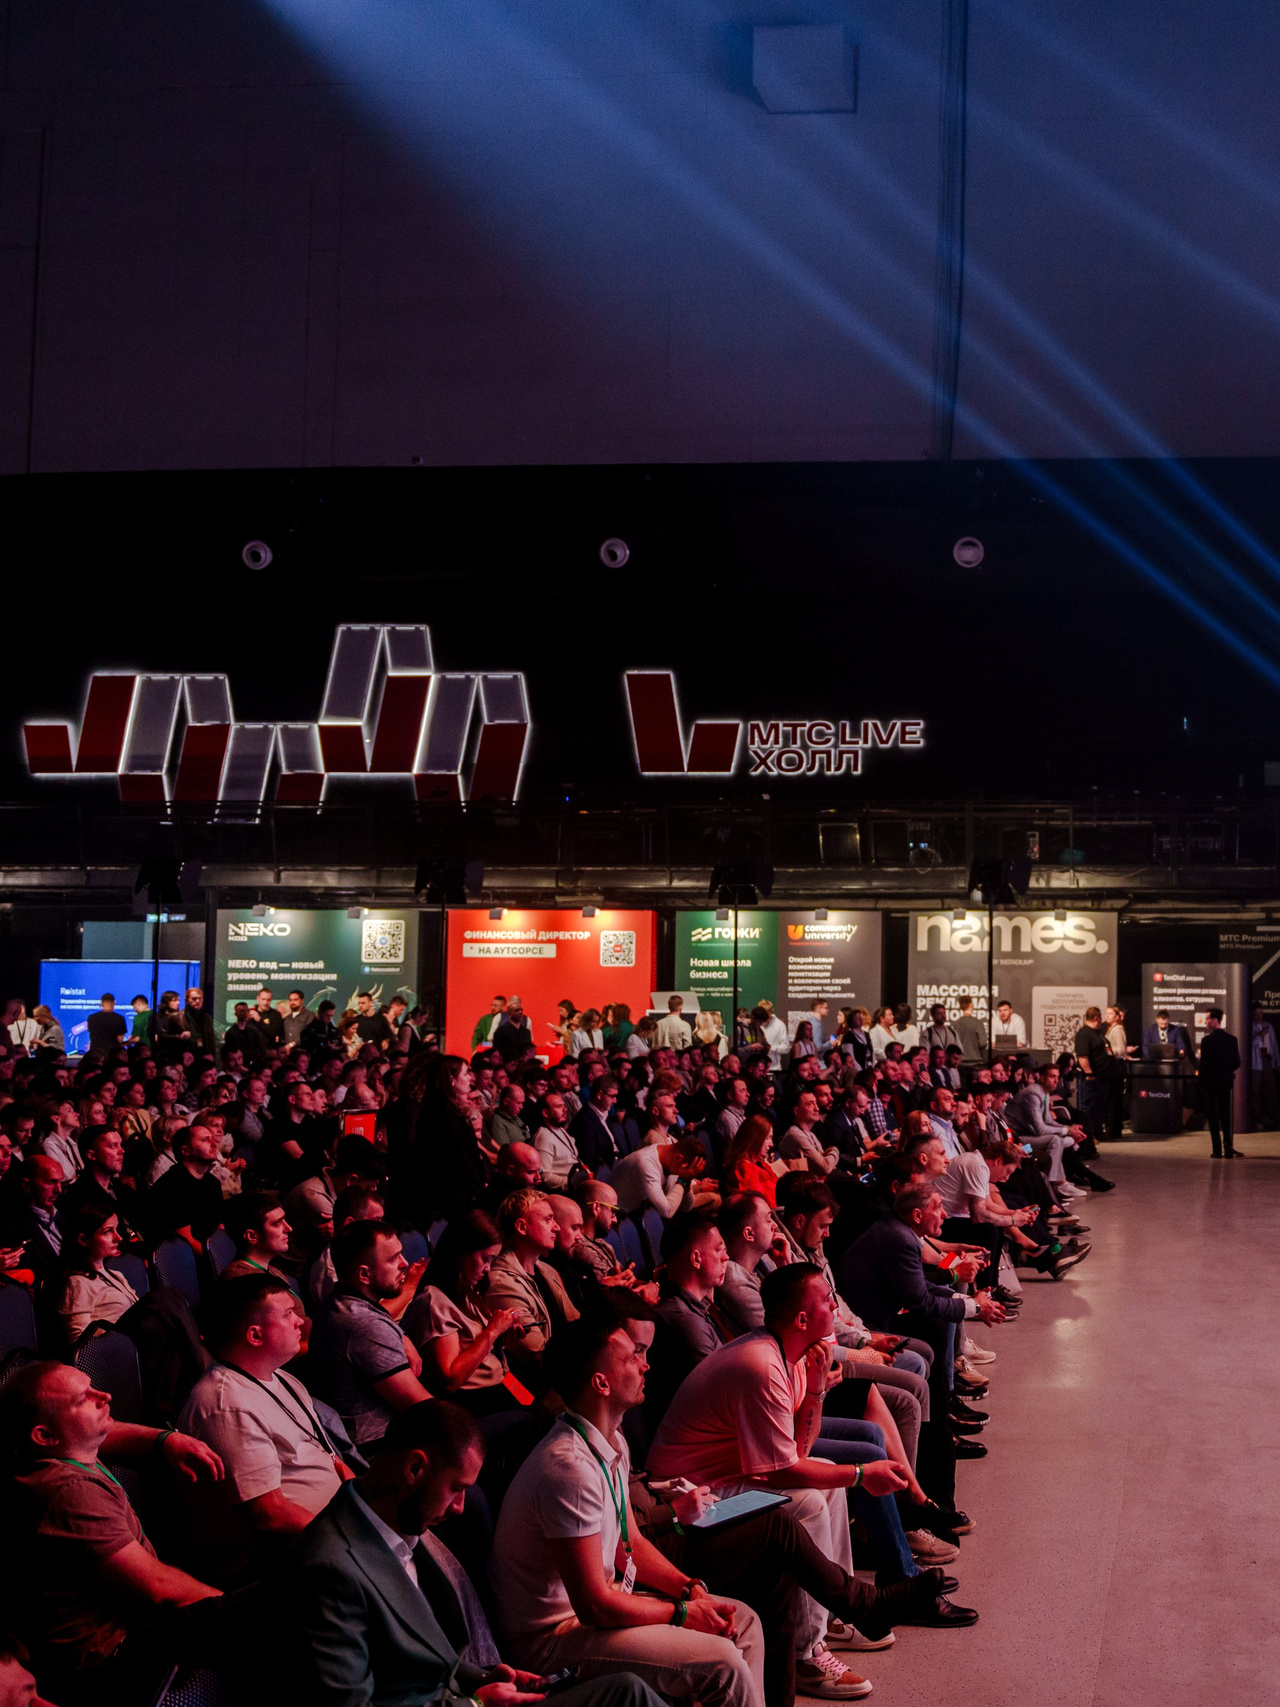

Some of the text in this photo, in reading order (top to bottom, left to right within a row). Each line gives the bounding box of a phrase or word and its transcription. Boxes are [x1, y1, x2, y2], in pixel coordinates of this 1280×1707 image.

[749, 720, 924, 748] МТС LIVE
[750, 748, 862, 775] ХОЛЛ
[228, 922, 291, 936] NEKO
[805, 924, 858, 934] community
[464, 929, 591, 941] ФИНАНСОВЫЙ ДИРЕКТОР
[805, 932, 853, 942] university
[1219, 934, 1240, 942] МТС
[493, 947, 544, 955] АУТСОРСЕ
[228, 959, 257, 969] NEKO
[258, 961, 278, 970] код
[291, 960, 324, 969] новый
[690, 958, 720, 967] Новая
[788, 956, 813, 964] Открой
[227, 972, 337, 982] уровень монетизации
[690, 969, 728, 979] бизнеса
[227, 982, 263, 991] знаний
[917, 984, 999, 997] МАССОВАЯ
